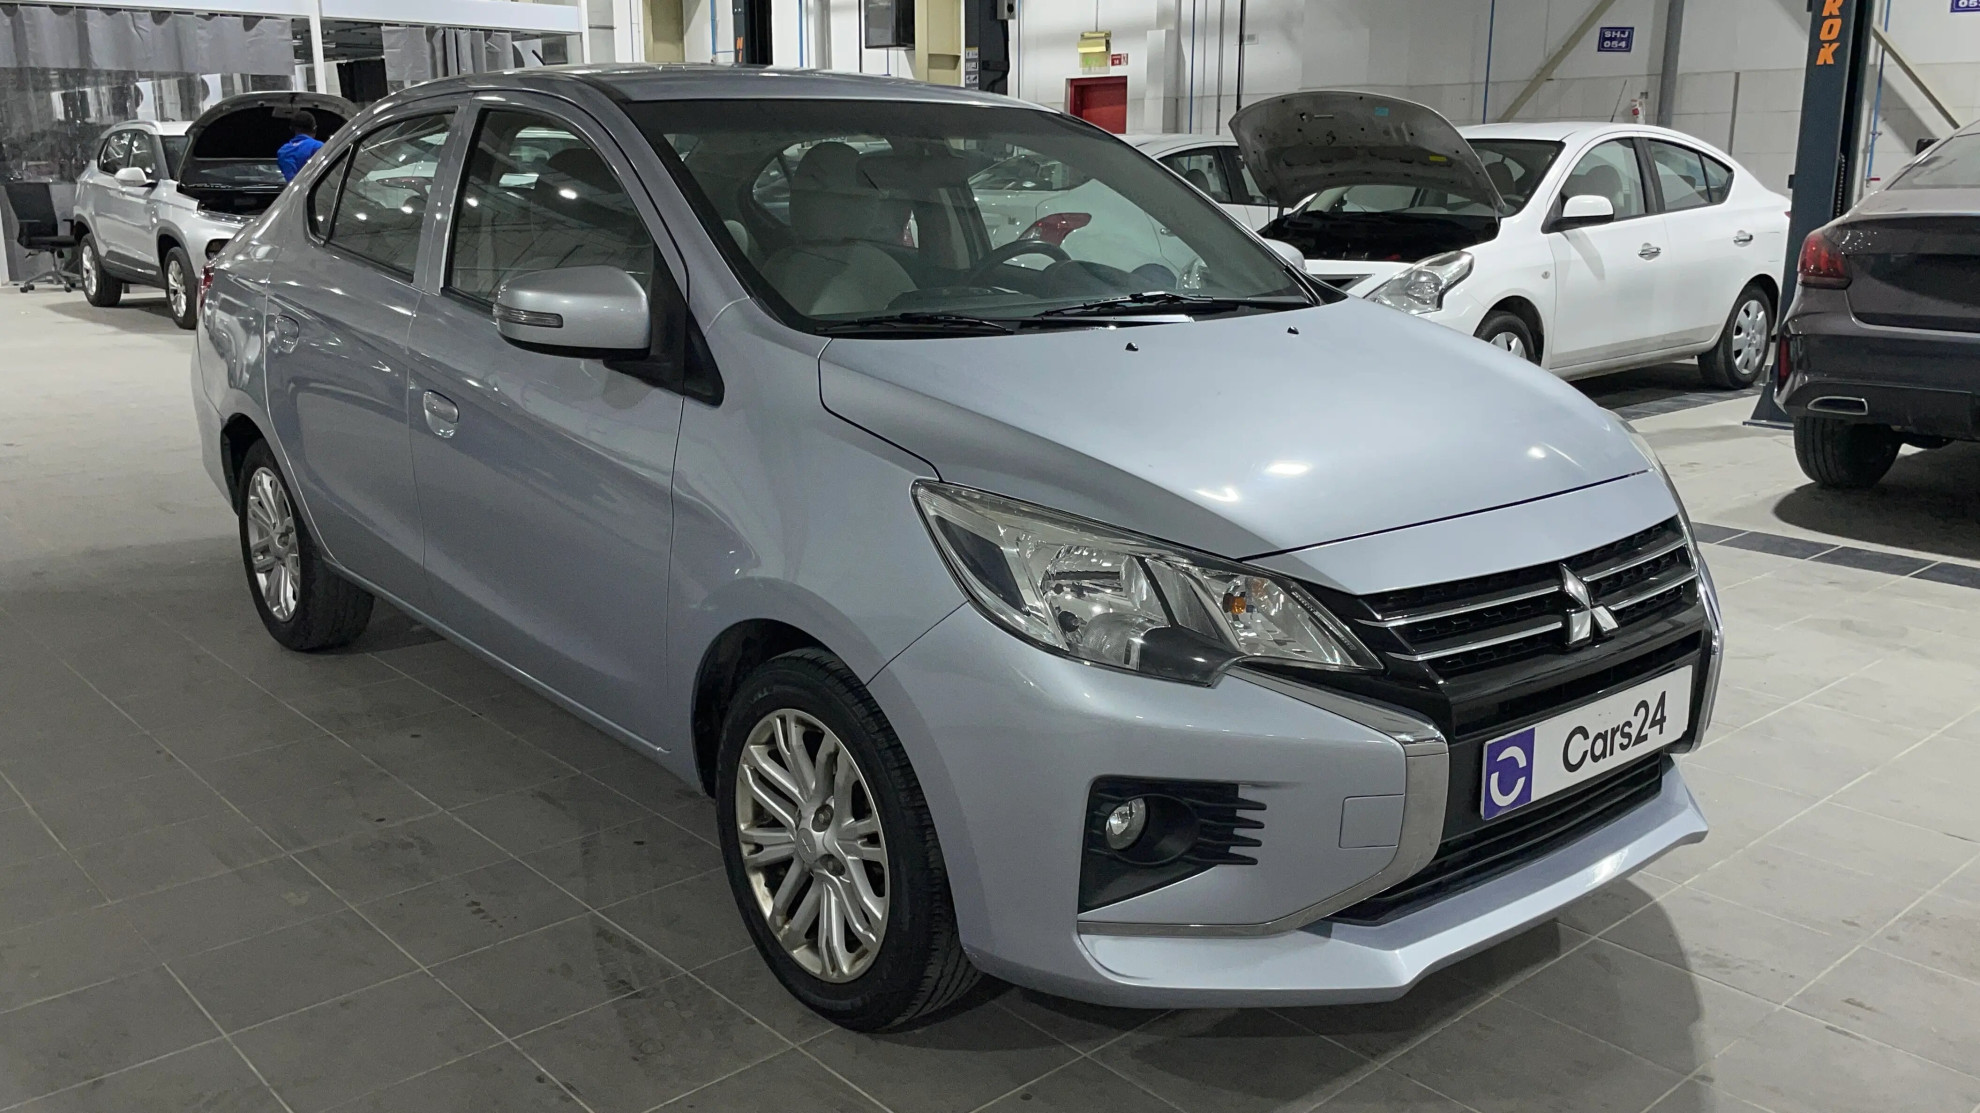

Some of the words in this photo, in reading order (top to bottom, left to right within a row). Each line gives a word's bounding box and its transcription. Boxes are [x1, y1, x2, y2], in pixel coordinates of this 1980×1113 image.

[1604, 30, 1629, 38] SHJ
[1603, 40, 1626, 48] 054
[1562, 691, 1667, 773] Cars24
